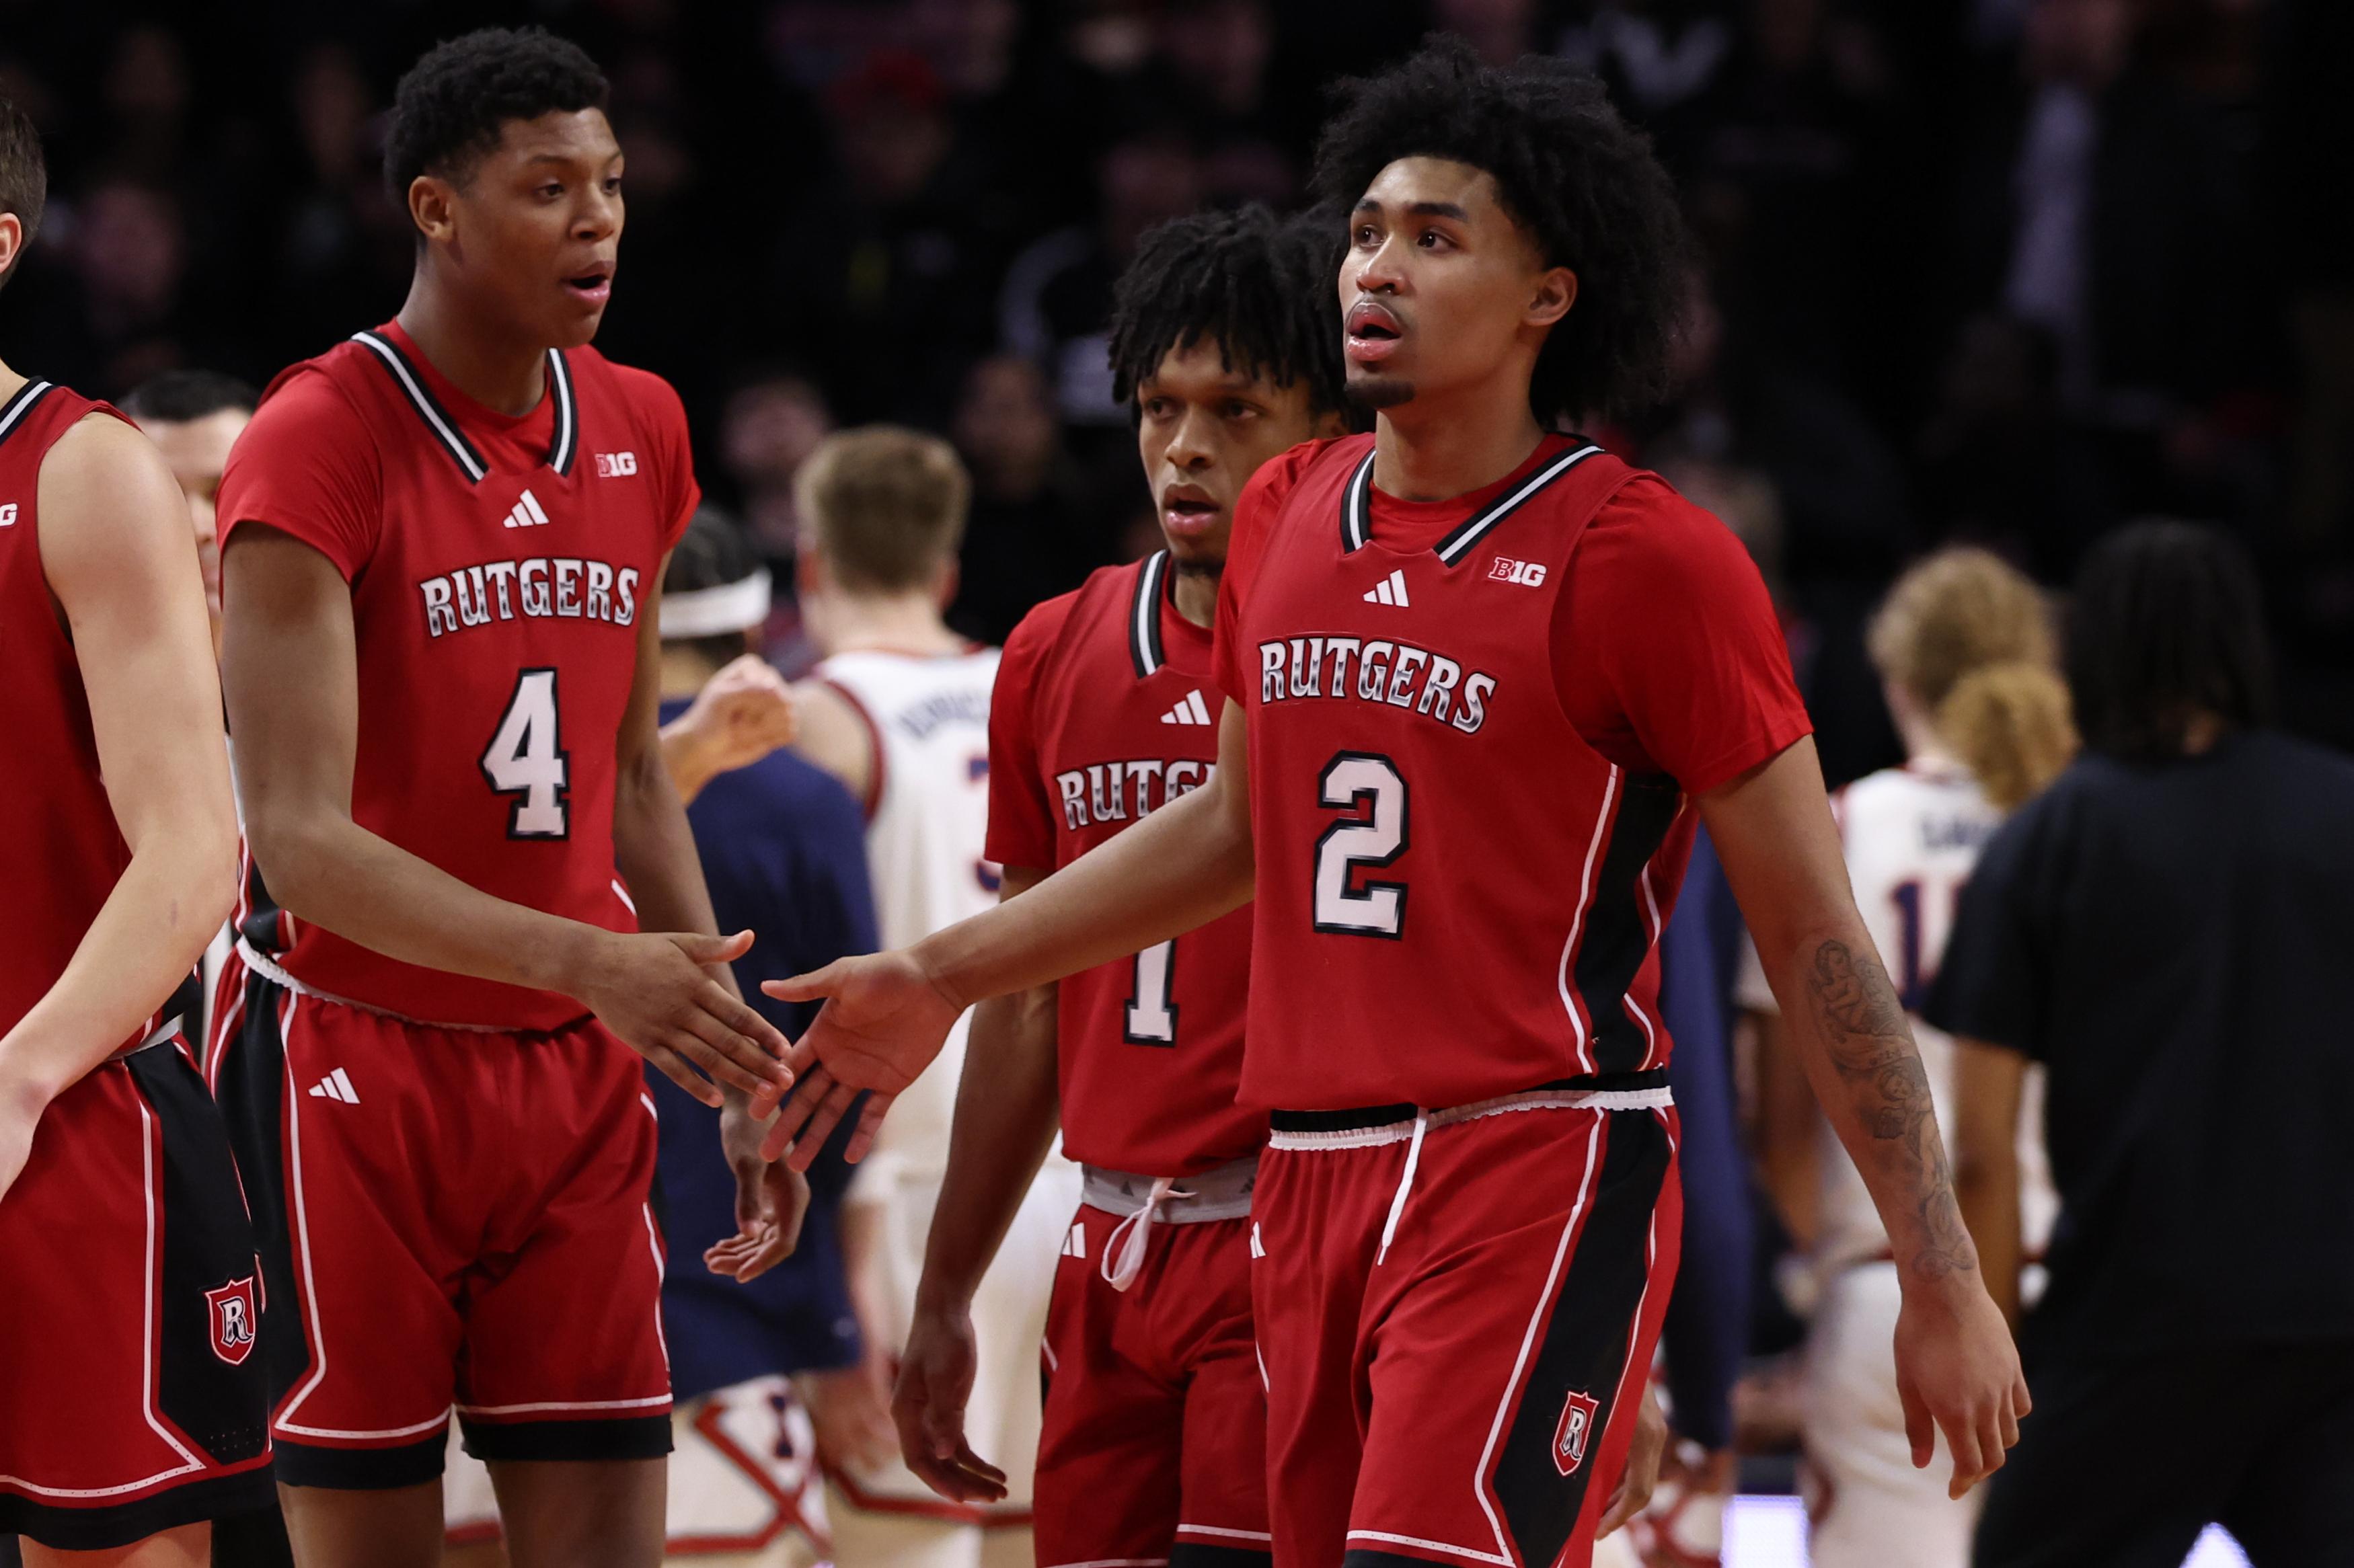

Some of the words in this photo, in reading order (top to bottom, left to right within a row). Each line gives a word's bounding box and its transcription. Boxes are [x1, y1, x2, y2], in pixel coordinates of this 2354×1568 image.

[419, 557, 640, 638] RUTGERS
[1258, 636, 1497, 734] RUTGERS
[477, 666, 570, 840] 4
[1055, 758, 1217, 831] RUTG
[1314, 749, 1410, 940] 2
[216, 1296, 255, 1348] R
[1559, 1405, 1583, 1461] R
